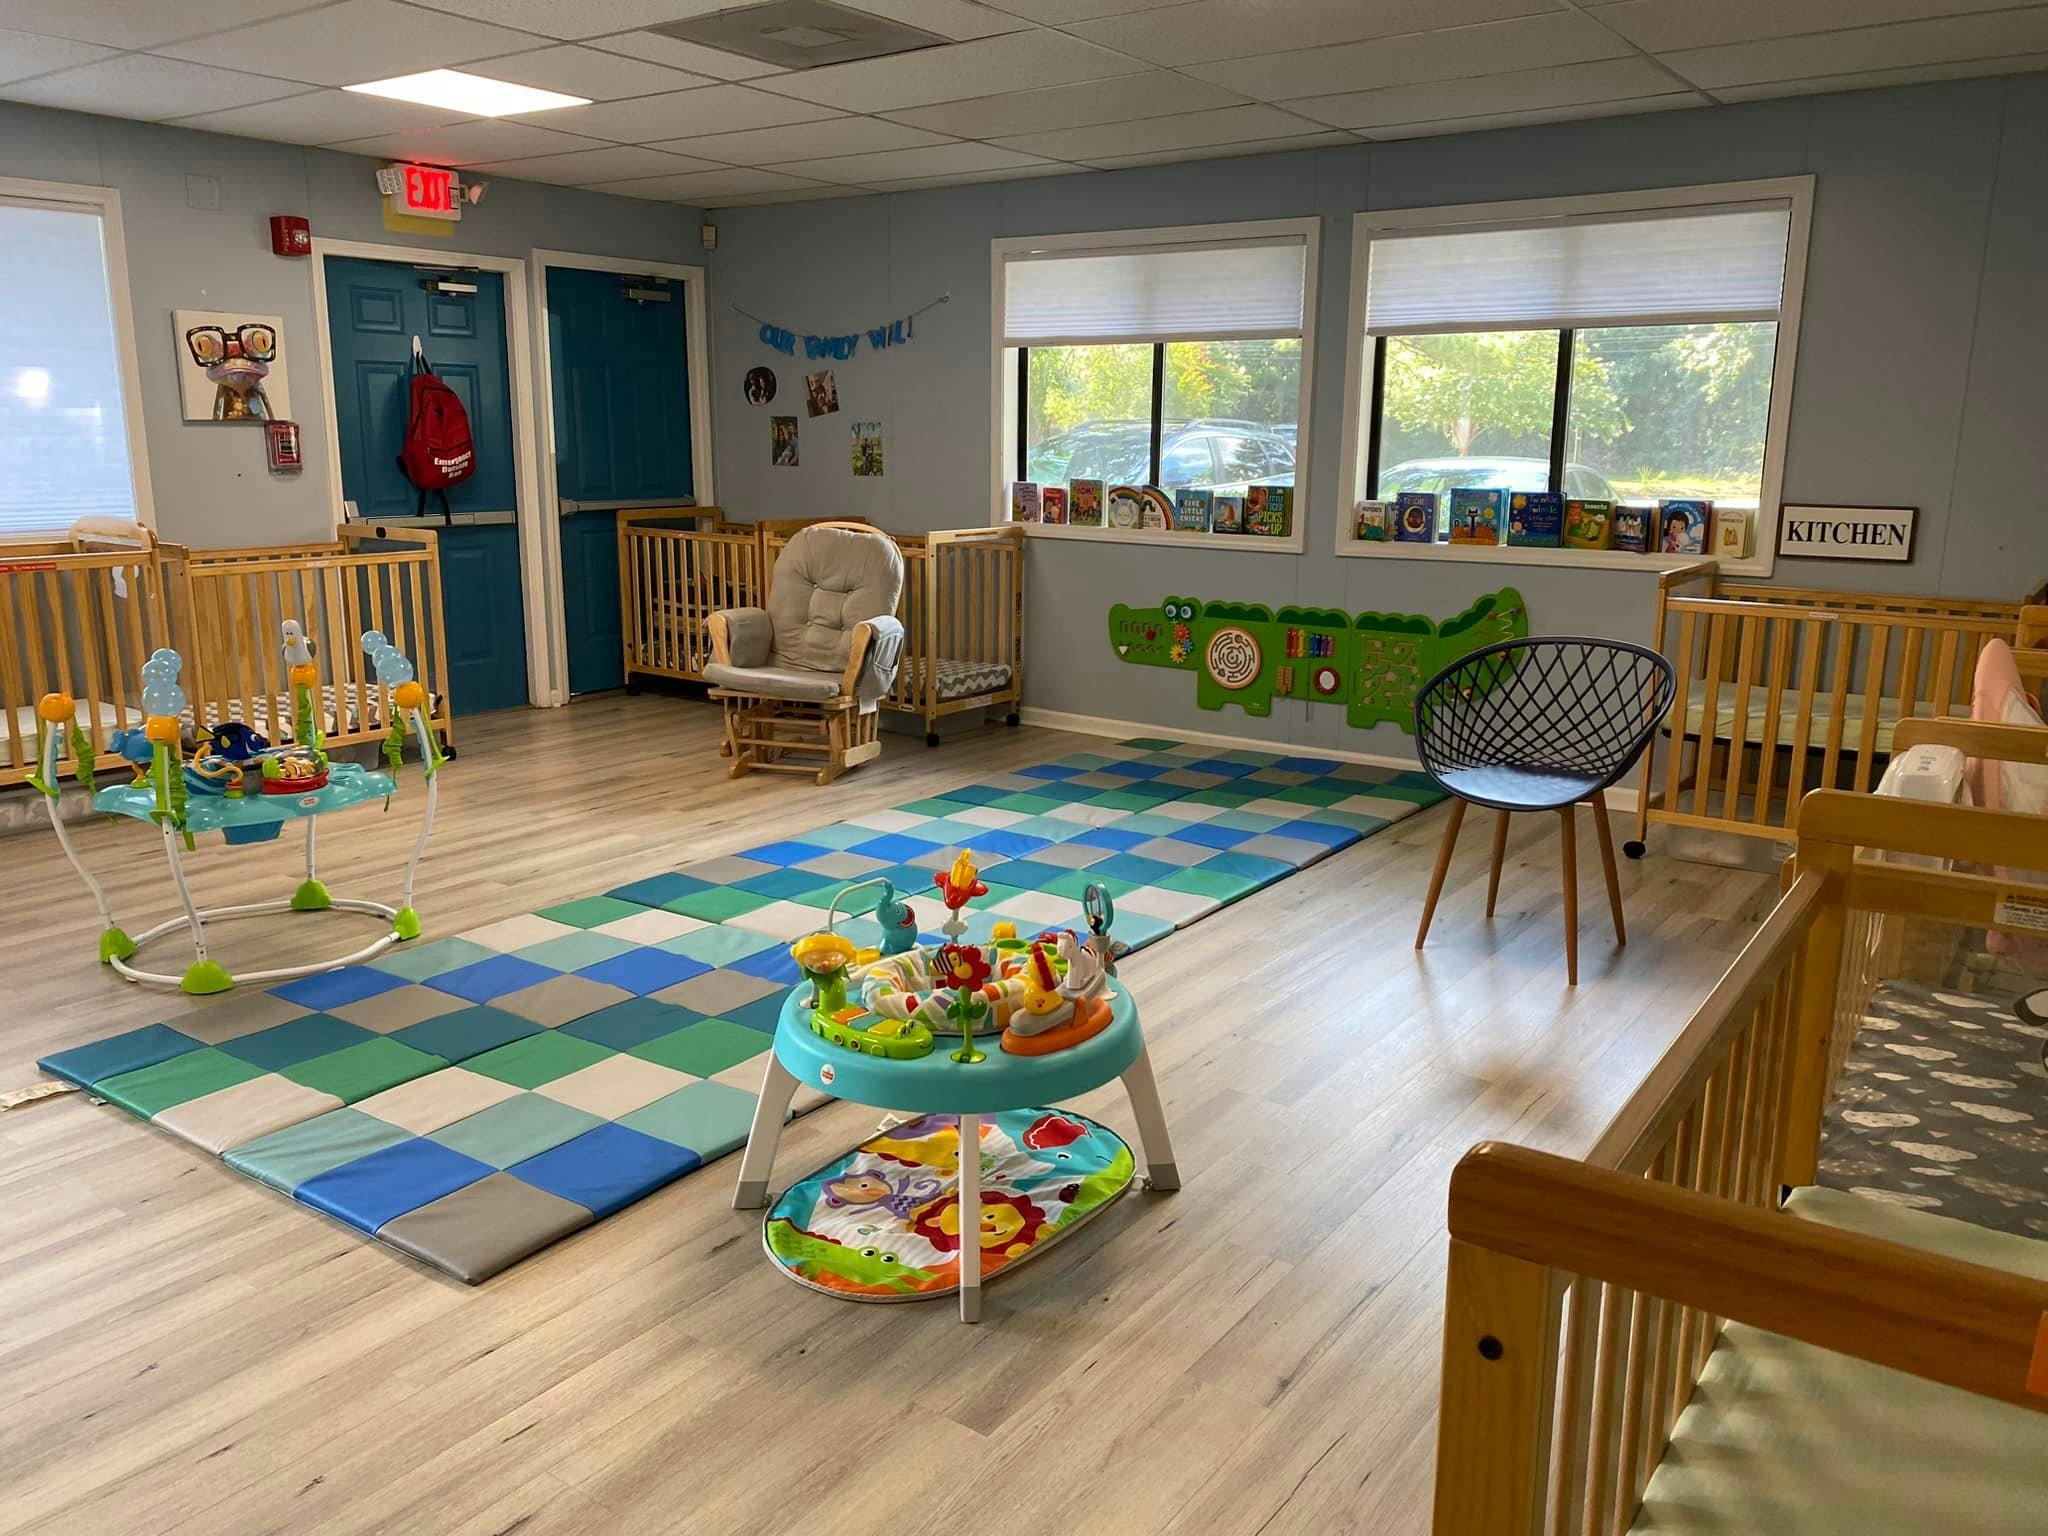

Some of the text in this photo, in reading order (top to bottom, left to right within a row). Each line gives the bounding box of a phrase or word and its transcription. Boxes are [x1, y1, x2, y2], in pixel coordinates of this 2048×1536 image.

[405, 167, 451, 212] EXIT
[759, 323, 796, 357] OUR
[1258, 511, 1283, 523] PICKS
[1270, 523, 1283, 535] UP
[1786, 520, 1907, 546] KITCHEN
